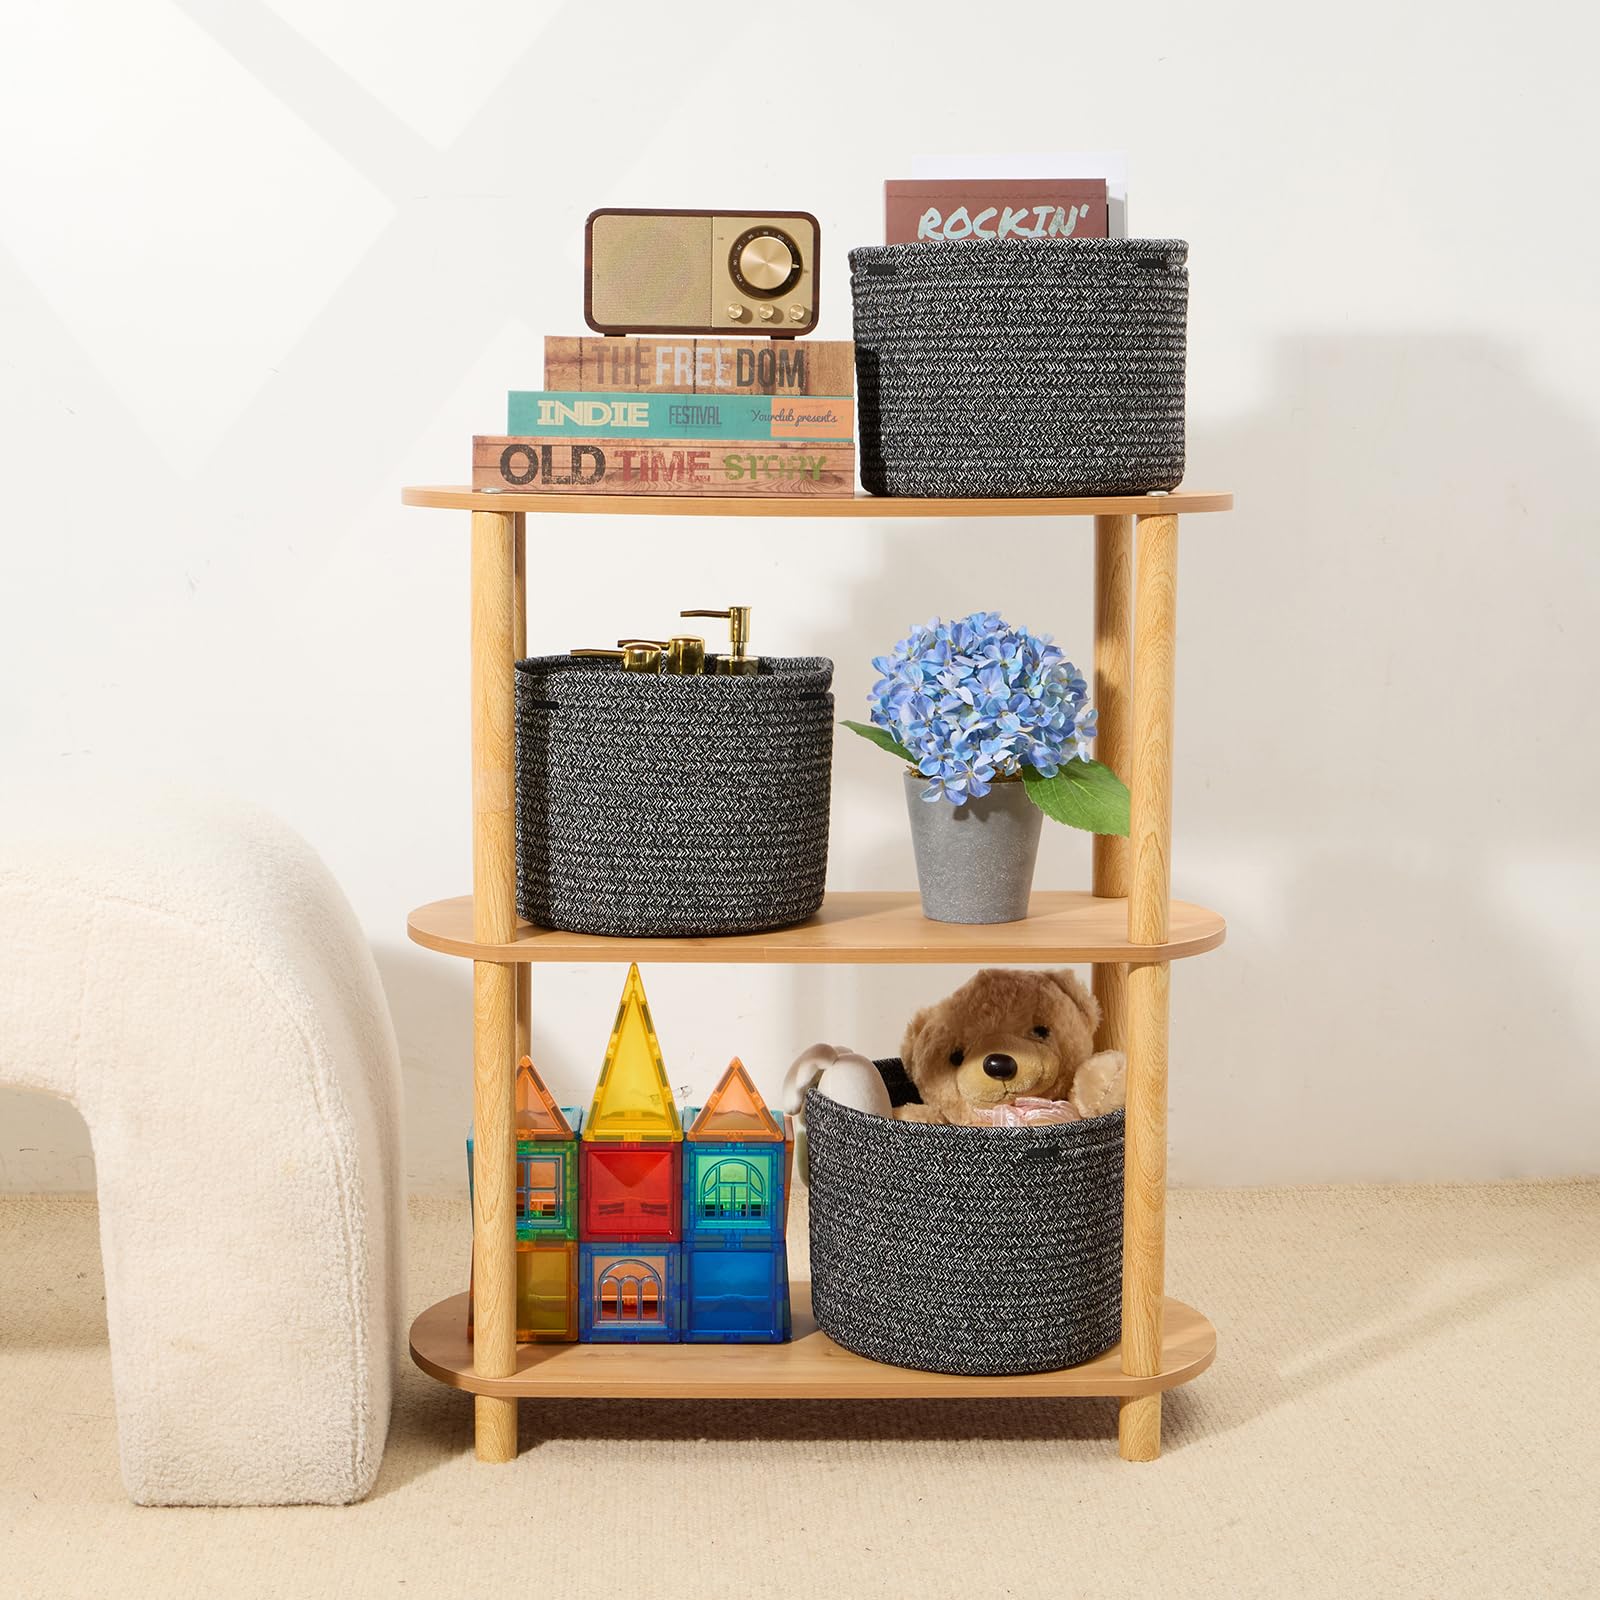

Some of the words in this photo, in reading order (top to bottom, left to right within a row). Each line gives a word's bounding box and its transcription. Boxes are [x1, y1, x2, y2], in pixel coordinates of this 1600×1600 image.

[917, 203, 1089, 241] ROCKIN'
[593, 345, 652, 385] THE
[537, 400, 649, 427] INDIE
[669, 405, 722, 425] FESTIVAL
[794, 410, 838, 427] presents
[500, 444, 606, 485] OLD
[614, 450, 711, 482] TIME
[723, 454, 827, 480] STORY
